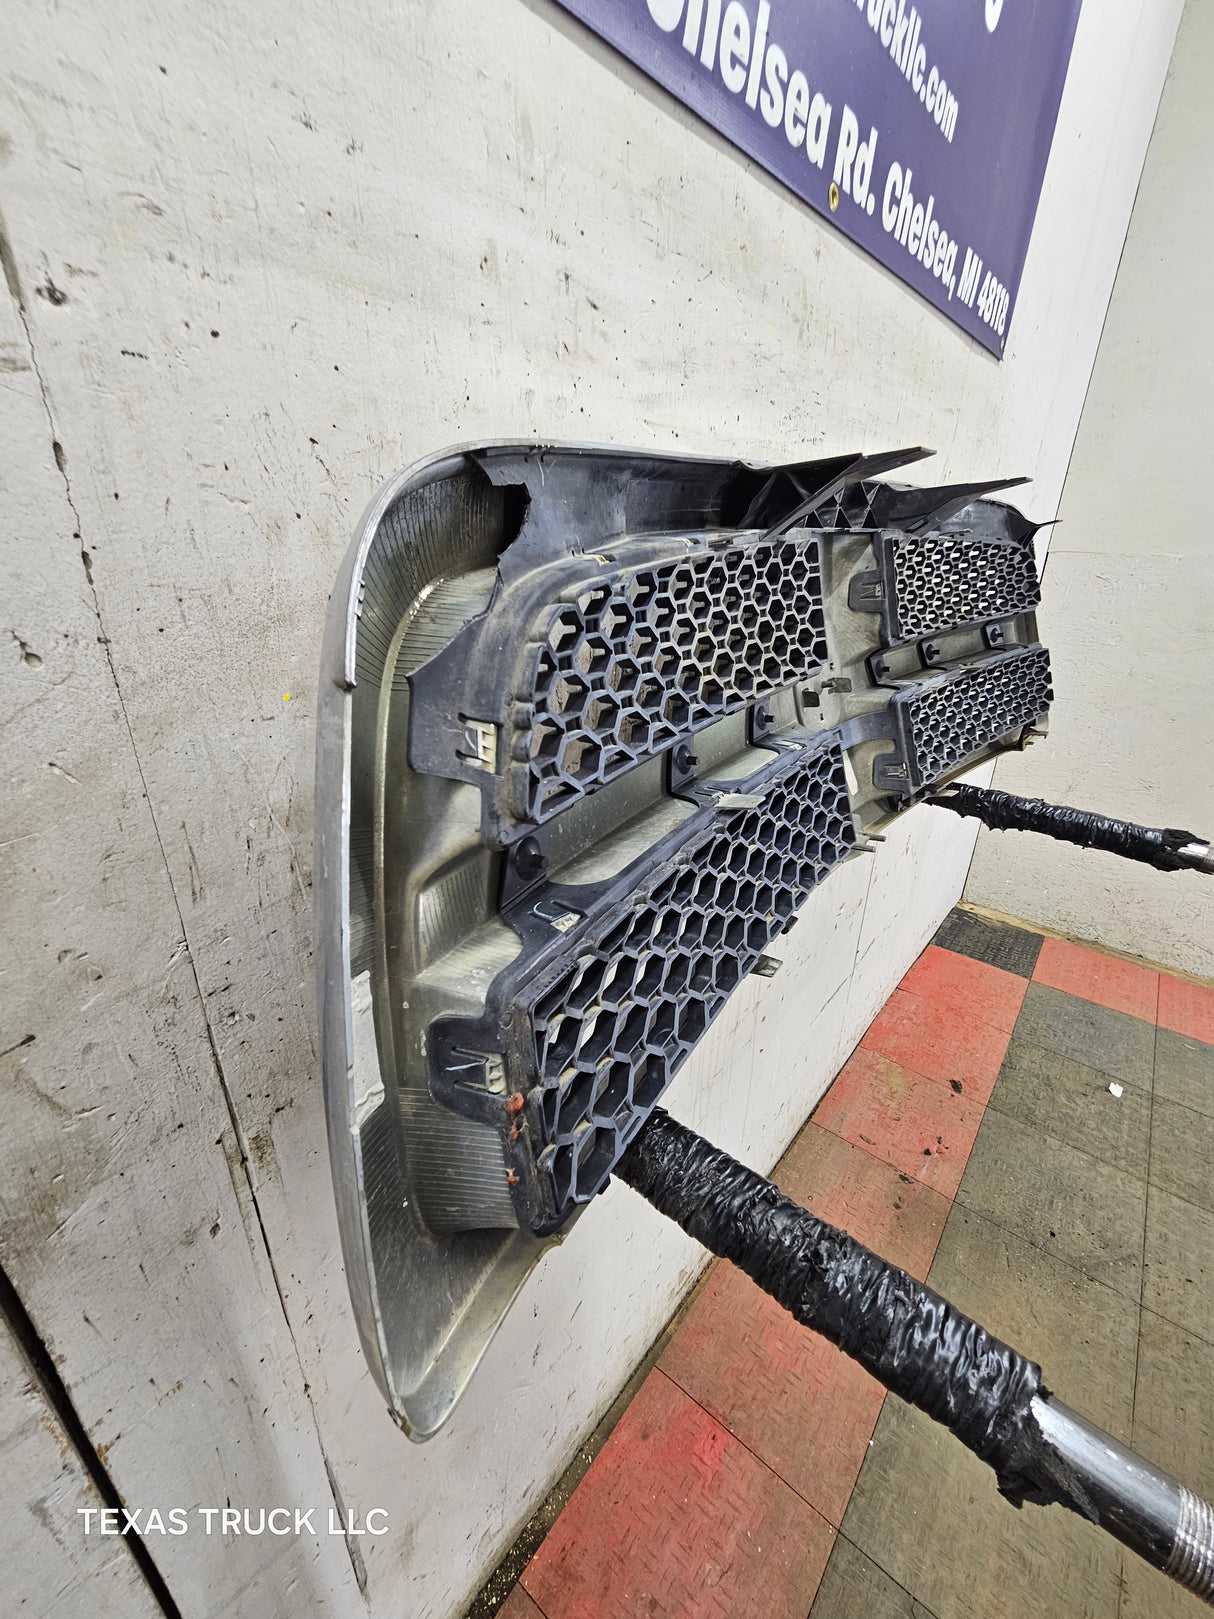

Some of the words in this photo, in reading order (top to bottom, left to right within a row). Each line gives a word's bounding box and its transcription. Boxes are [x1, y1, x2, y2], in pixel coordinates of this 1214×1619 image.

[646, 0, 832, 169] helsea
[833, 104, 879, 216] Rd.
[882, 161, 958, 301] Chelsea,
[956, 246, 984, 309] MI
[977, 270, 1010, 336] 48118
[856, 0, 959, 143] uckllc.com
